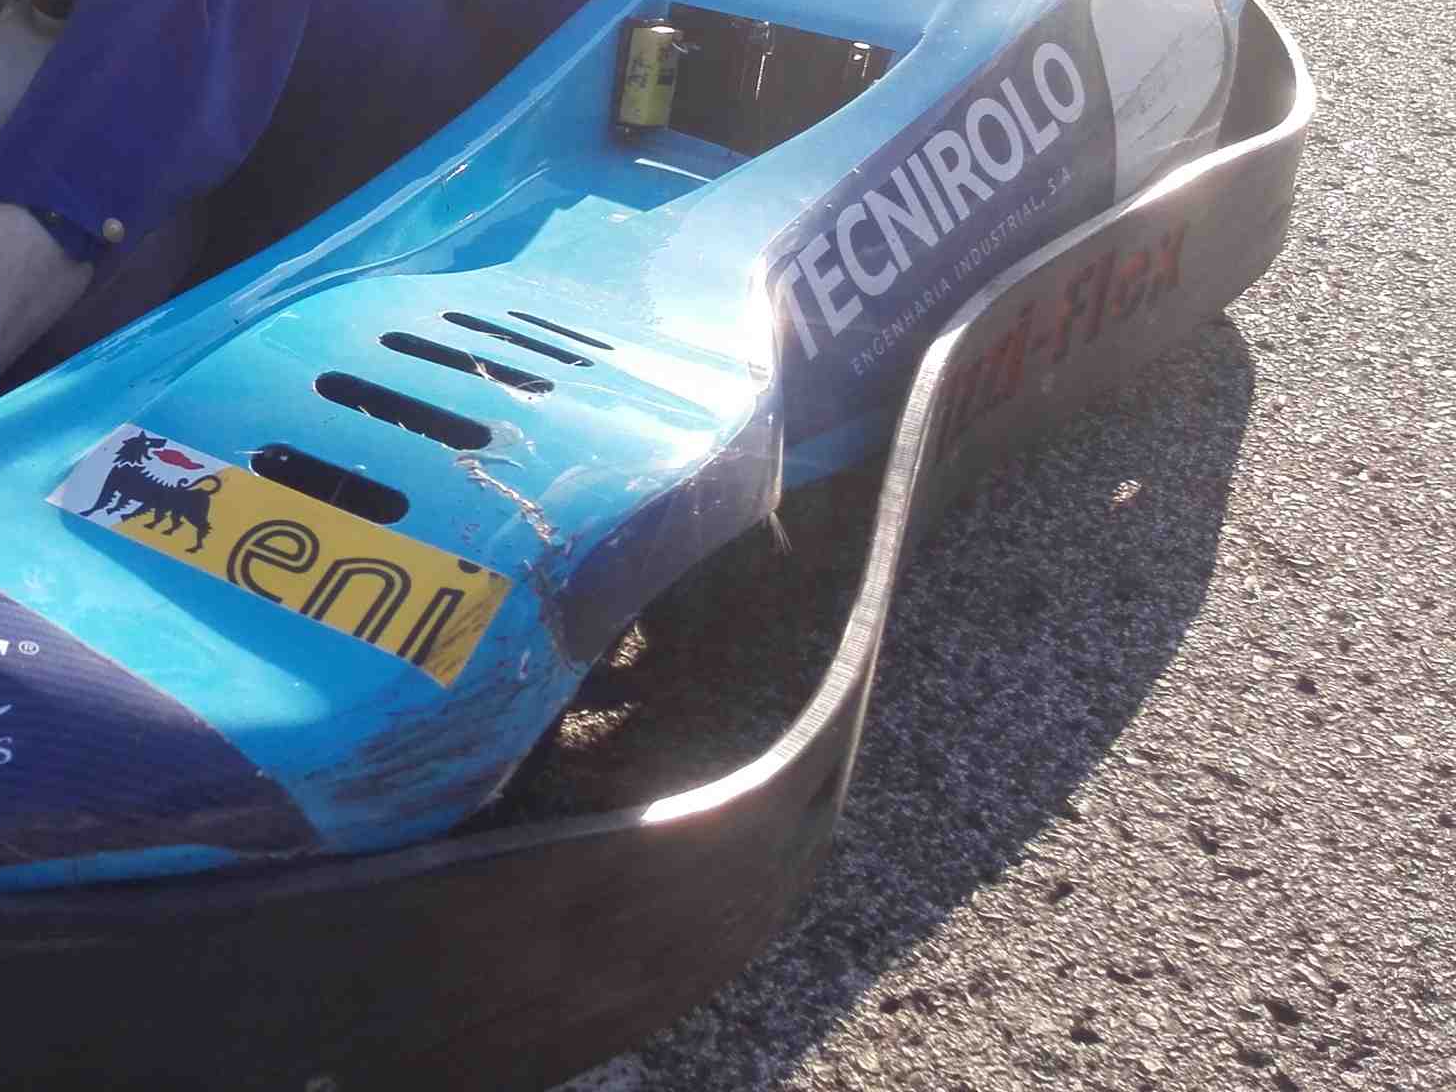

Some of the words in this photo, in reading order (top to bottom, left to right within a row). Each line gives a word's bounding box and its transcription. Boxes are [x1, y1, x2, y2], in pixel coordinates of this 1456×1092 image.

[774, 42, 1086, 361] TECNIROLO
[852, 277, 952, 377] ENGENHARIA
[227, 519, 482, 666] eni
